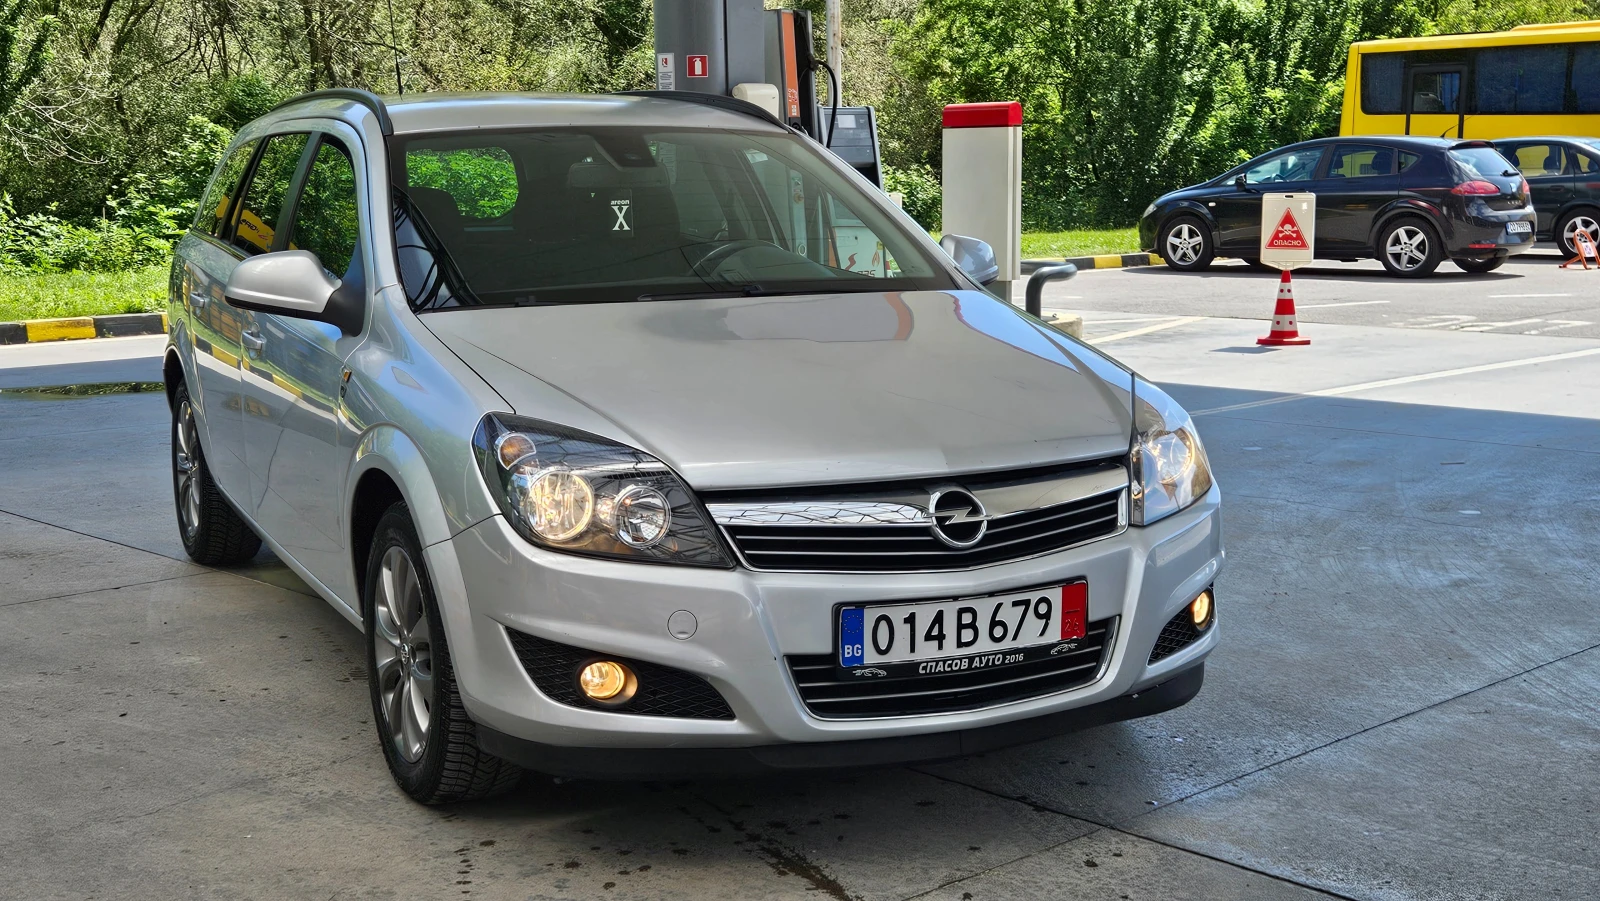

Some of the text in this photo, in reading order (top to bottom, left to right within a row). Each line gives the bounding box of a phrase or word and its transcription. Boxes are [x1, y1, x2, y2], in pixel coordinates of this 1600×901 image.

[611, 206, 631, 231] X
[1273, 239, 1302, 247] ОПАСНО
[871, 596, 1053, 656] 014B679
[844, 644, 862, 658] BG
[918, 653, 1024, 674] СПАСОВ АУТО 2016
